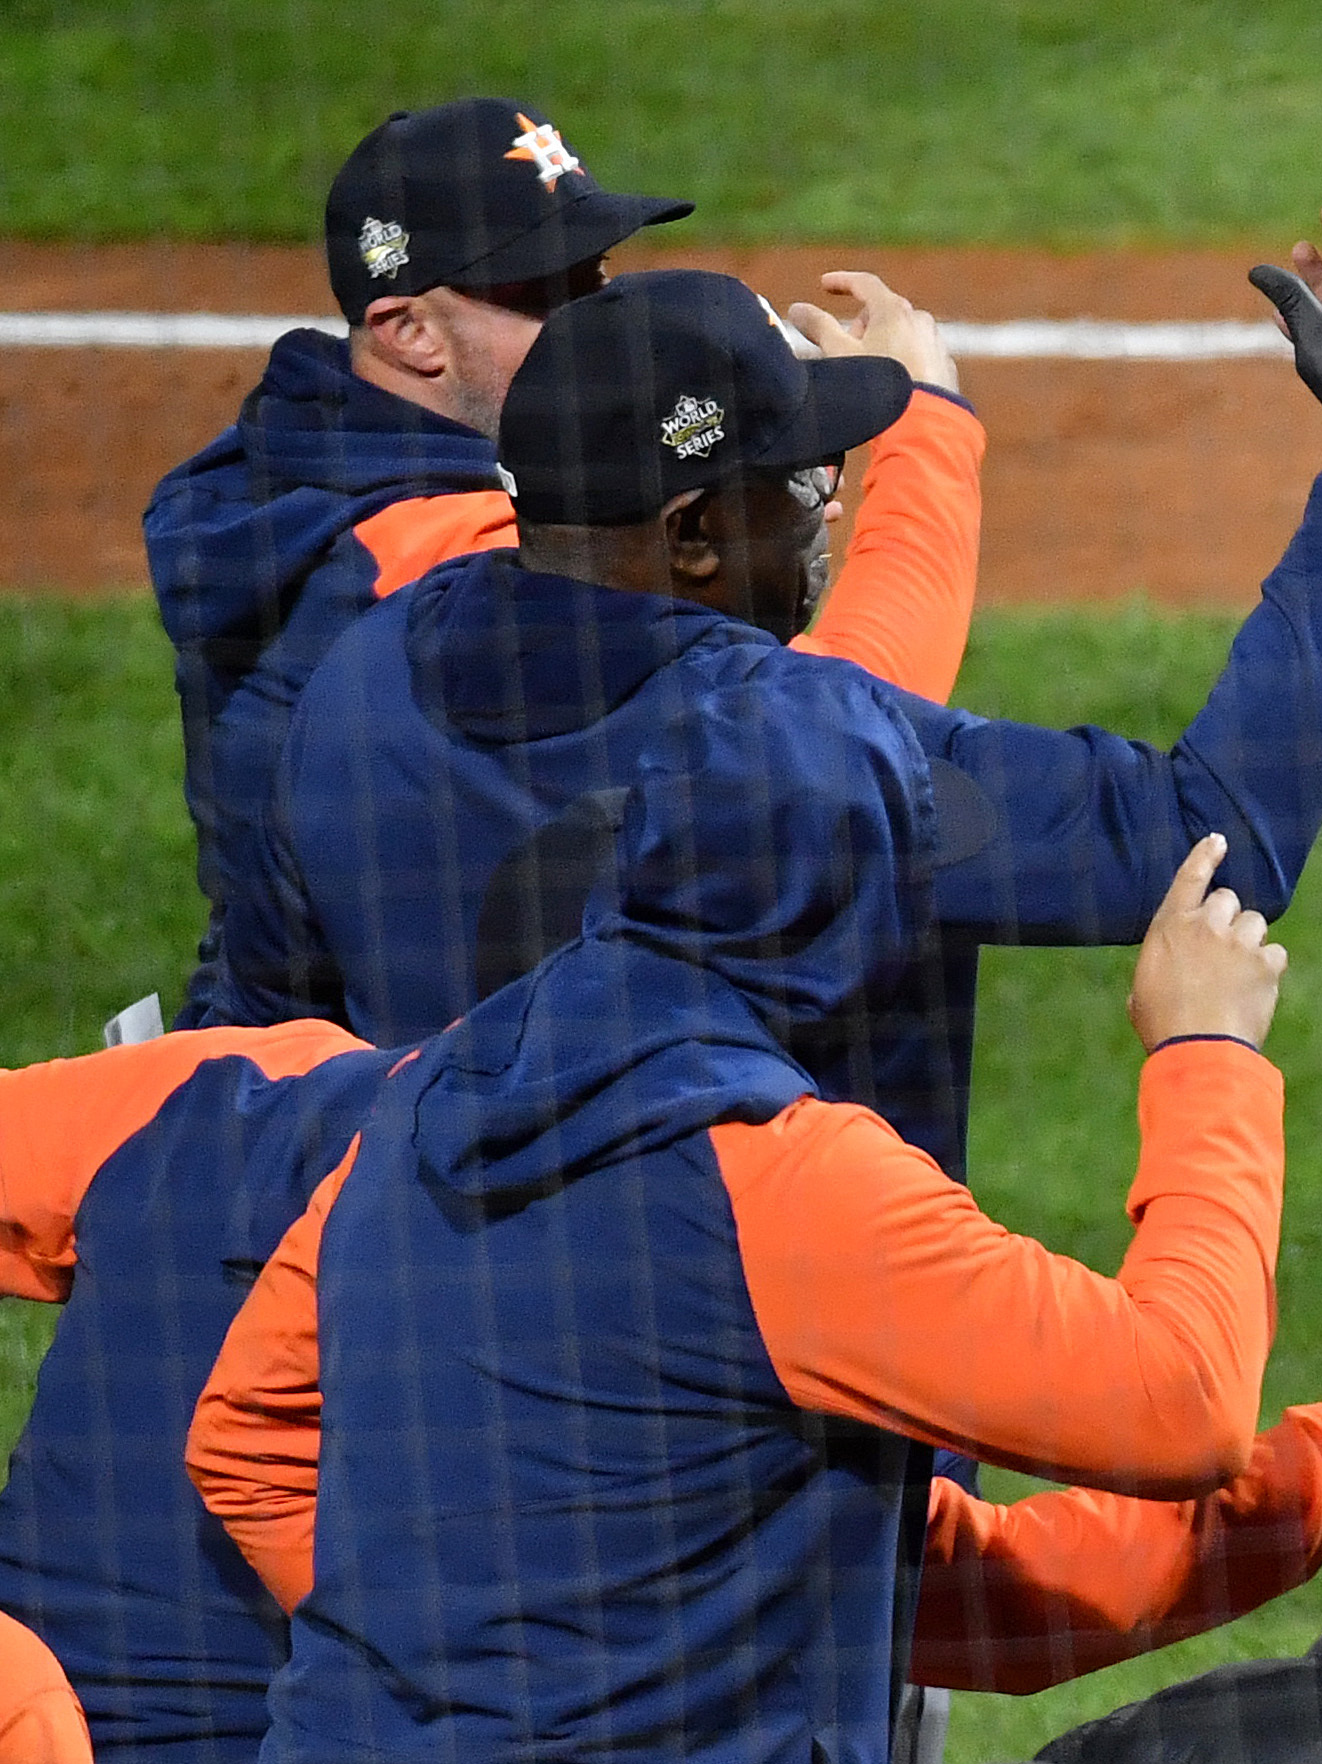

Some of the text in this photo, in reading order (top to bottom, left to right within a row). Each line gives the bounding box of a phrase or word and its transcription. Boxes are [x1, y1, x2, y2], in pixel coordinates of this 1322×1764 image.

[358, 224, 402, 252] WORLD
[368, 252, 409, 278] SERIES
[661, 401, 717, 435] WORLD
[677, 425, 725, 459] SERIES
